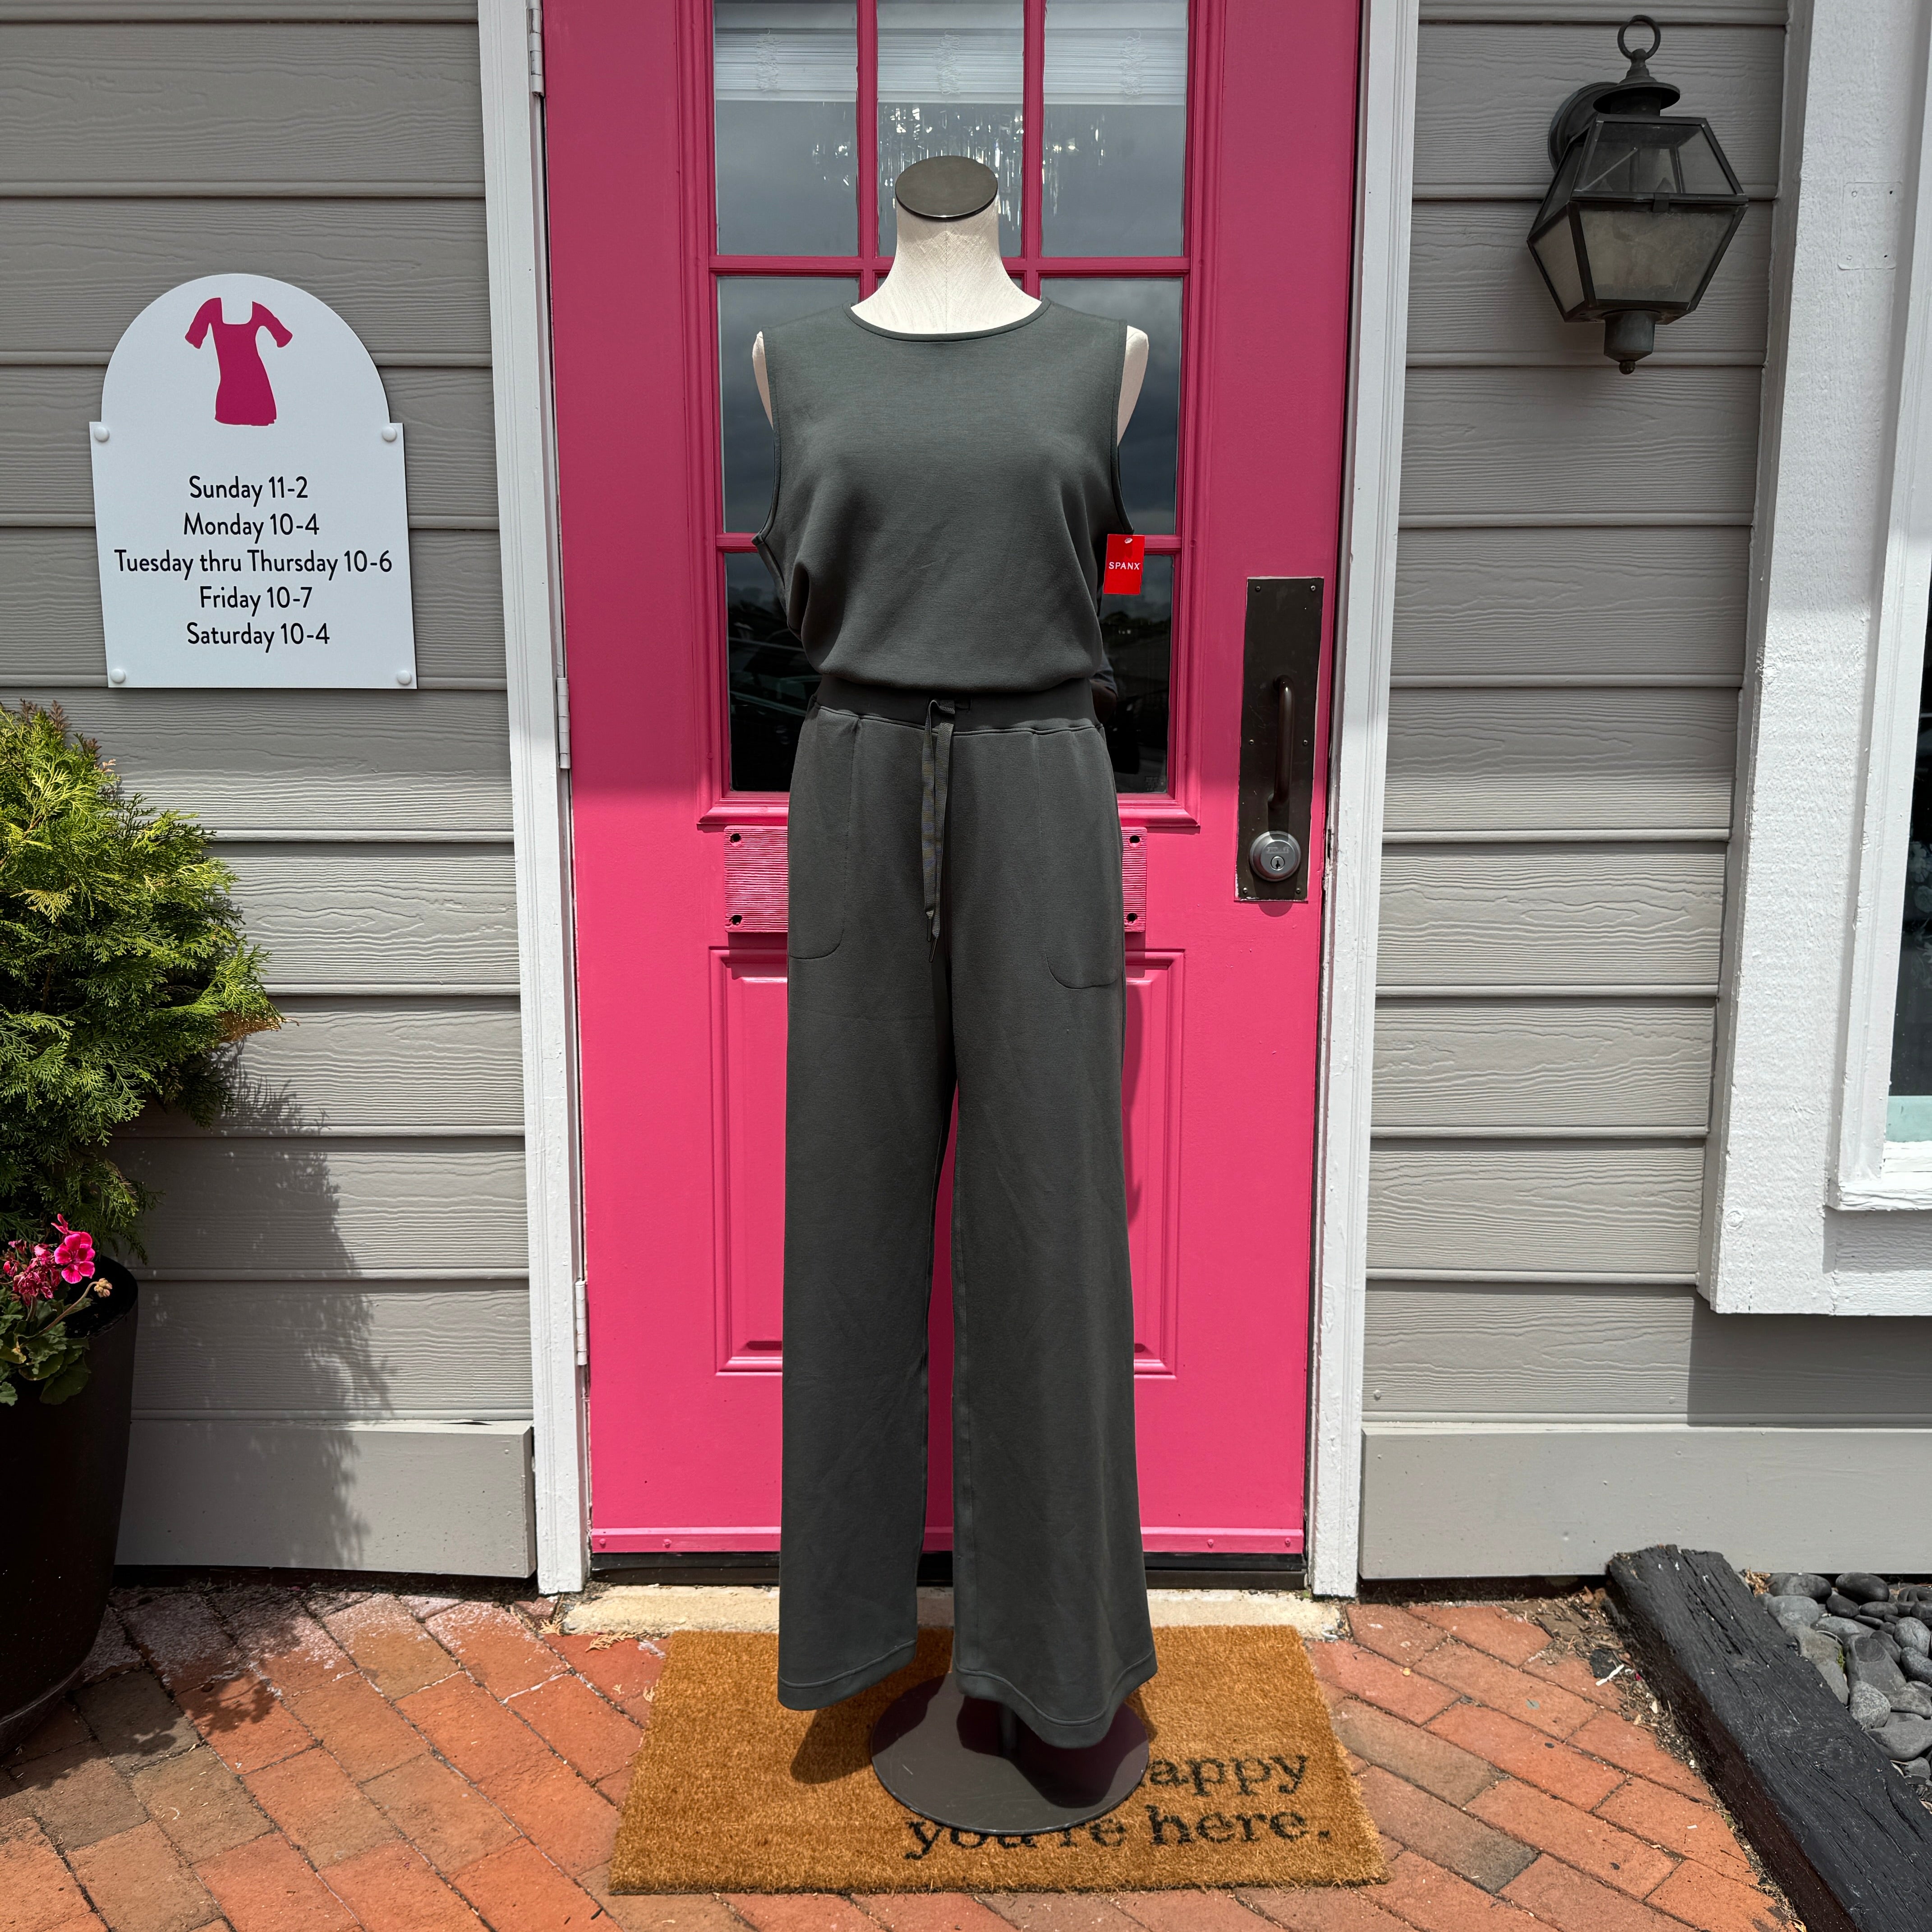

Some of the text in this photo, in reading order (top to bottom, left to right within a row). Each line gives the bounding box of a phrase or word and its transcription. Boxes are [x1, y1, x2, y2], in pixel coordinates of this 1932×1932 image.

[189, 475, 308, 507] Sunday 11-2
[184, 512, 320, 544] Monday 10-4
[114, 549, 392, 581] Tuesday thru Thursday 10-6
[1109, 561, 1141, 570] SPANX
[200, 586, 313, 617] Friday 10-7
[187, 622, 330, 653] Saturday 10-4
[1140, 1755, 1306, 1796] appy
[1145, 1804, 1330, 1845] here.
